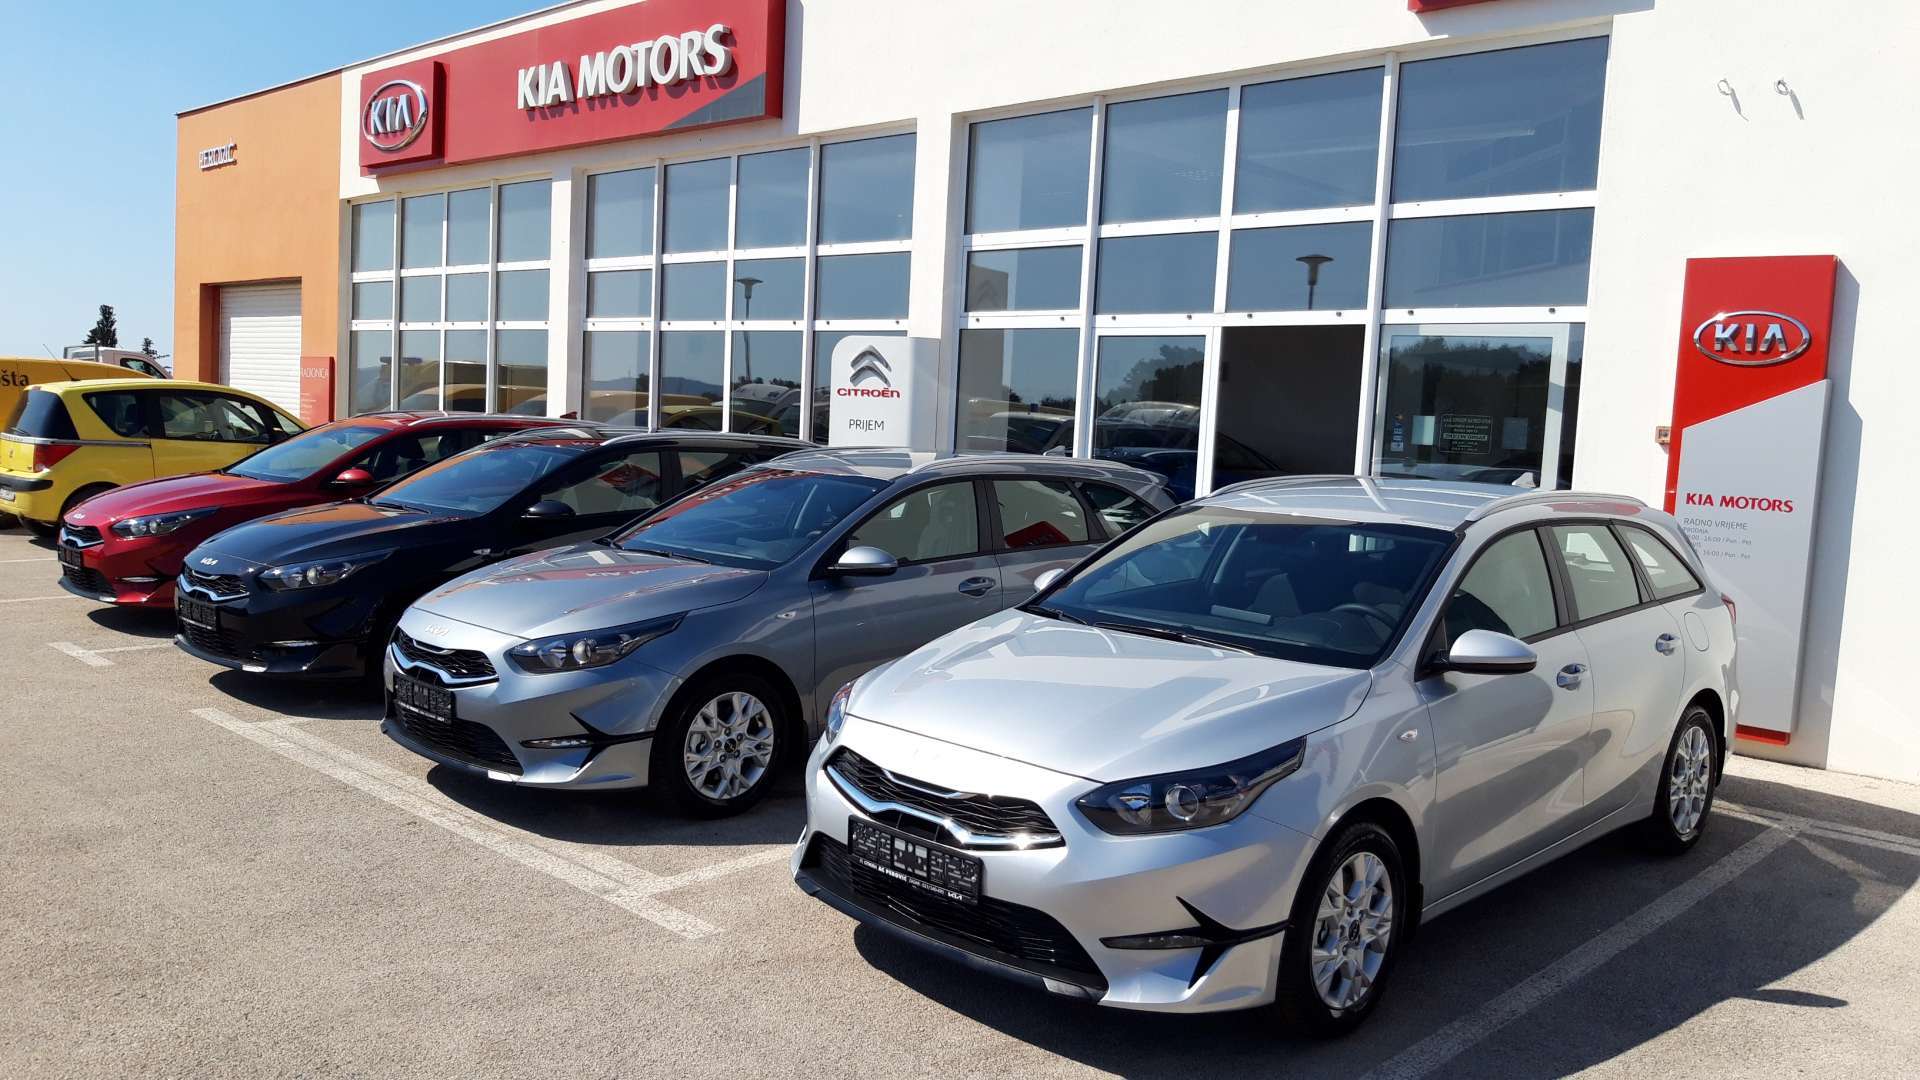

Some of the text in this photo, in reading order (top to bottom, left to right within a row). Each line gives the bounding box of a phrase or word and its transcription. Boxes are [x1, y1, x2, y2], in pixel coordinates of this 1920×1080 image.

[518, 24, 733, 109] KIA MOTORS
[848, 418, 885, 432] PRIJEM
[1685, 492, 1794, 513] KIA MOTORS
[1683, 518, 1749, 530] RADNO VRIJEME
